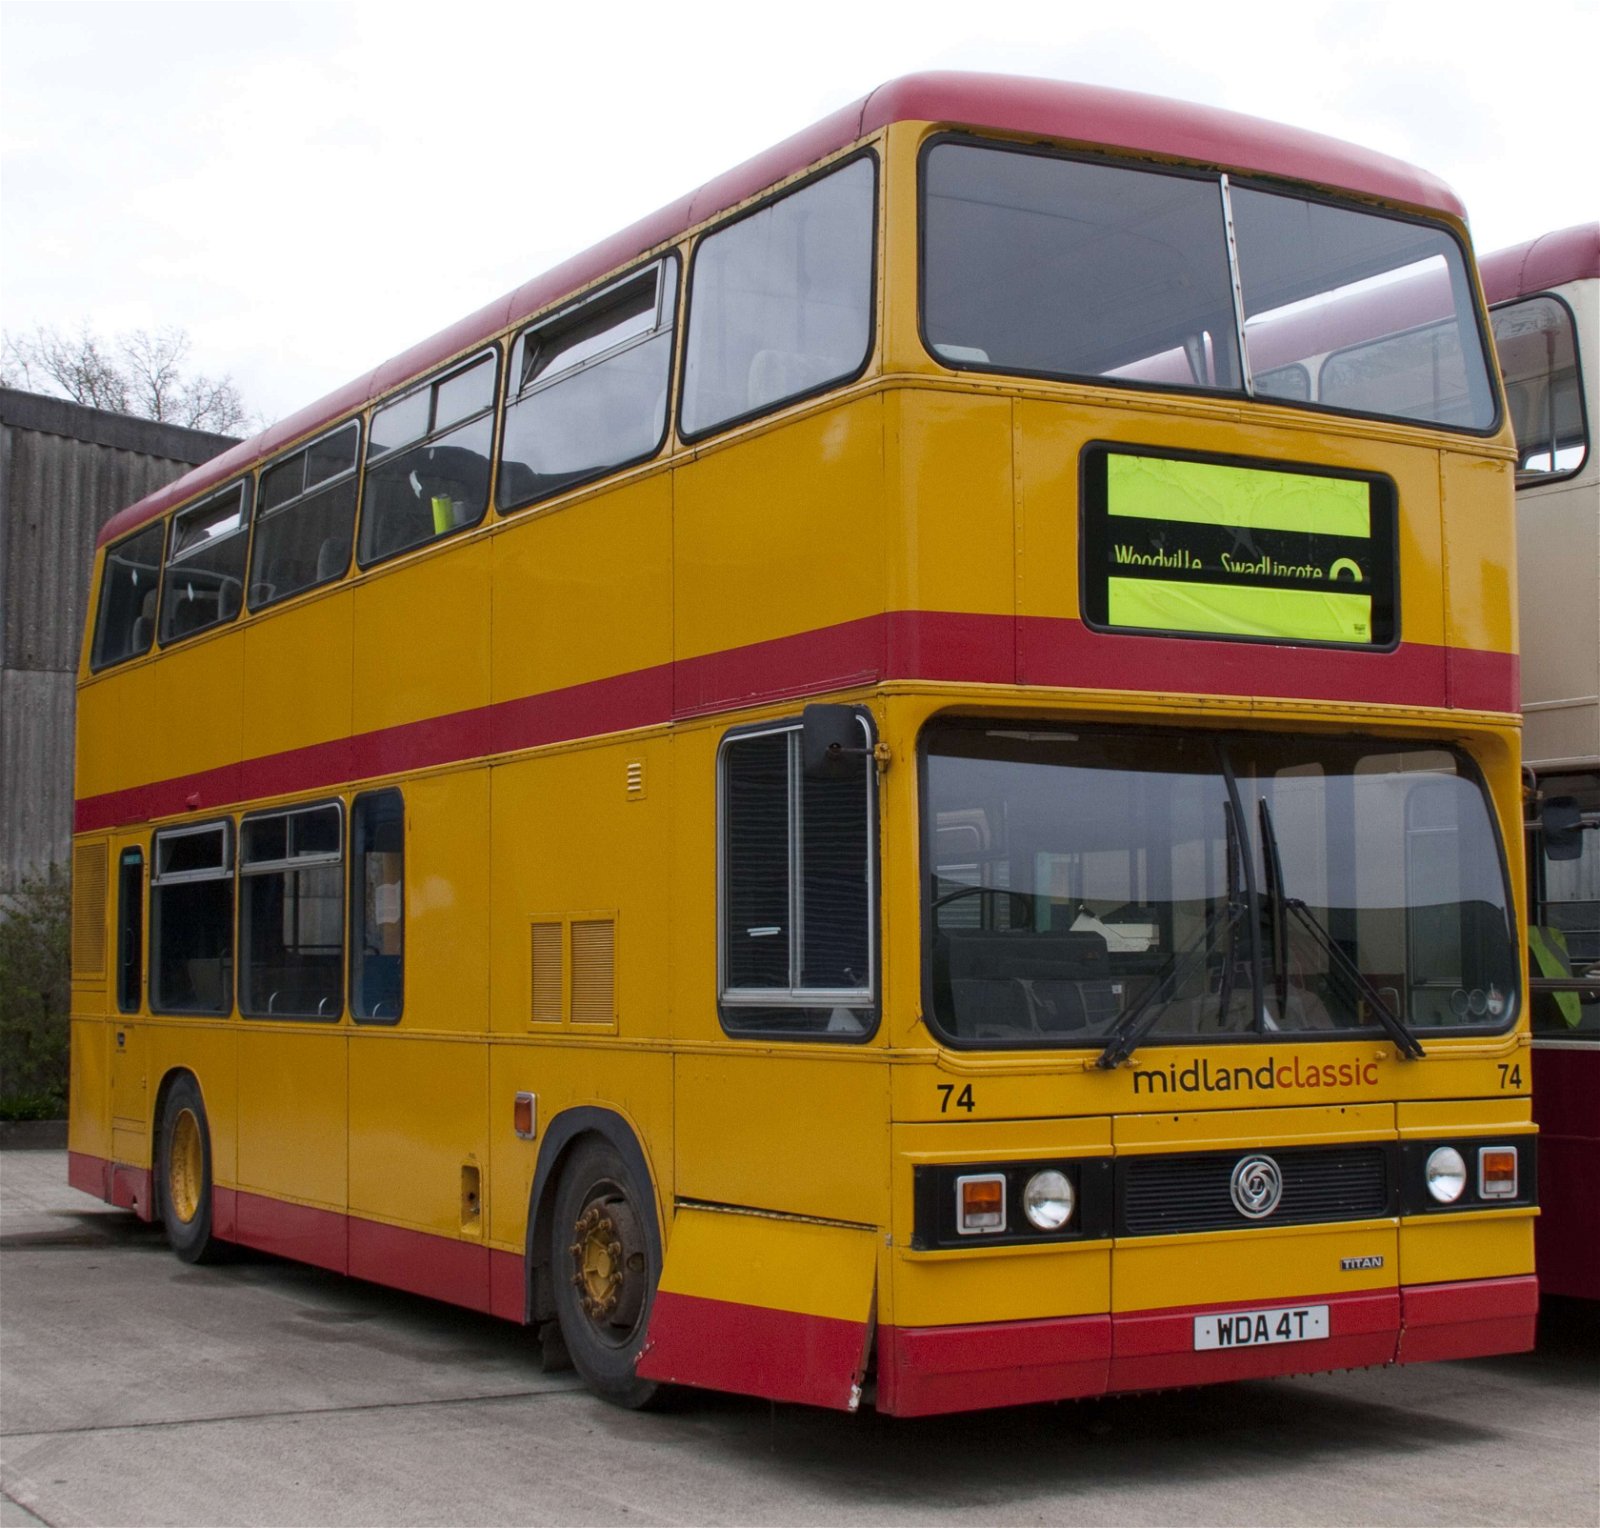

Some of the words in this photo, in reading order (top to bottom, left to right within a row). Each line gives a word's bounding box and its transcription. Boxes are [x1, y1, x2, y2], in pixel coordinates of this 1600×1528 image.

[1497, 1063, 1522, 1089] 74
[937, 1084, 976, 1113] 74
[1342, 1256, 1382, 1269] TITAN
[1217, 1314, 1270, 1346] WDA
[1275, 1310, 1309, 1340] 4T
